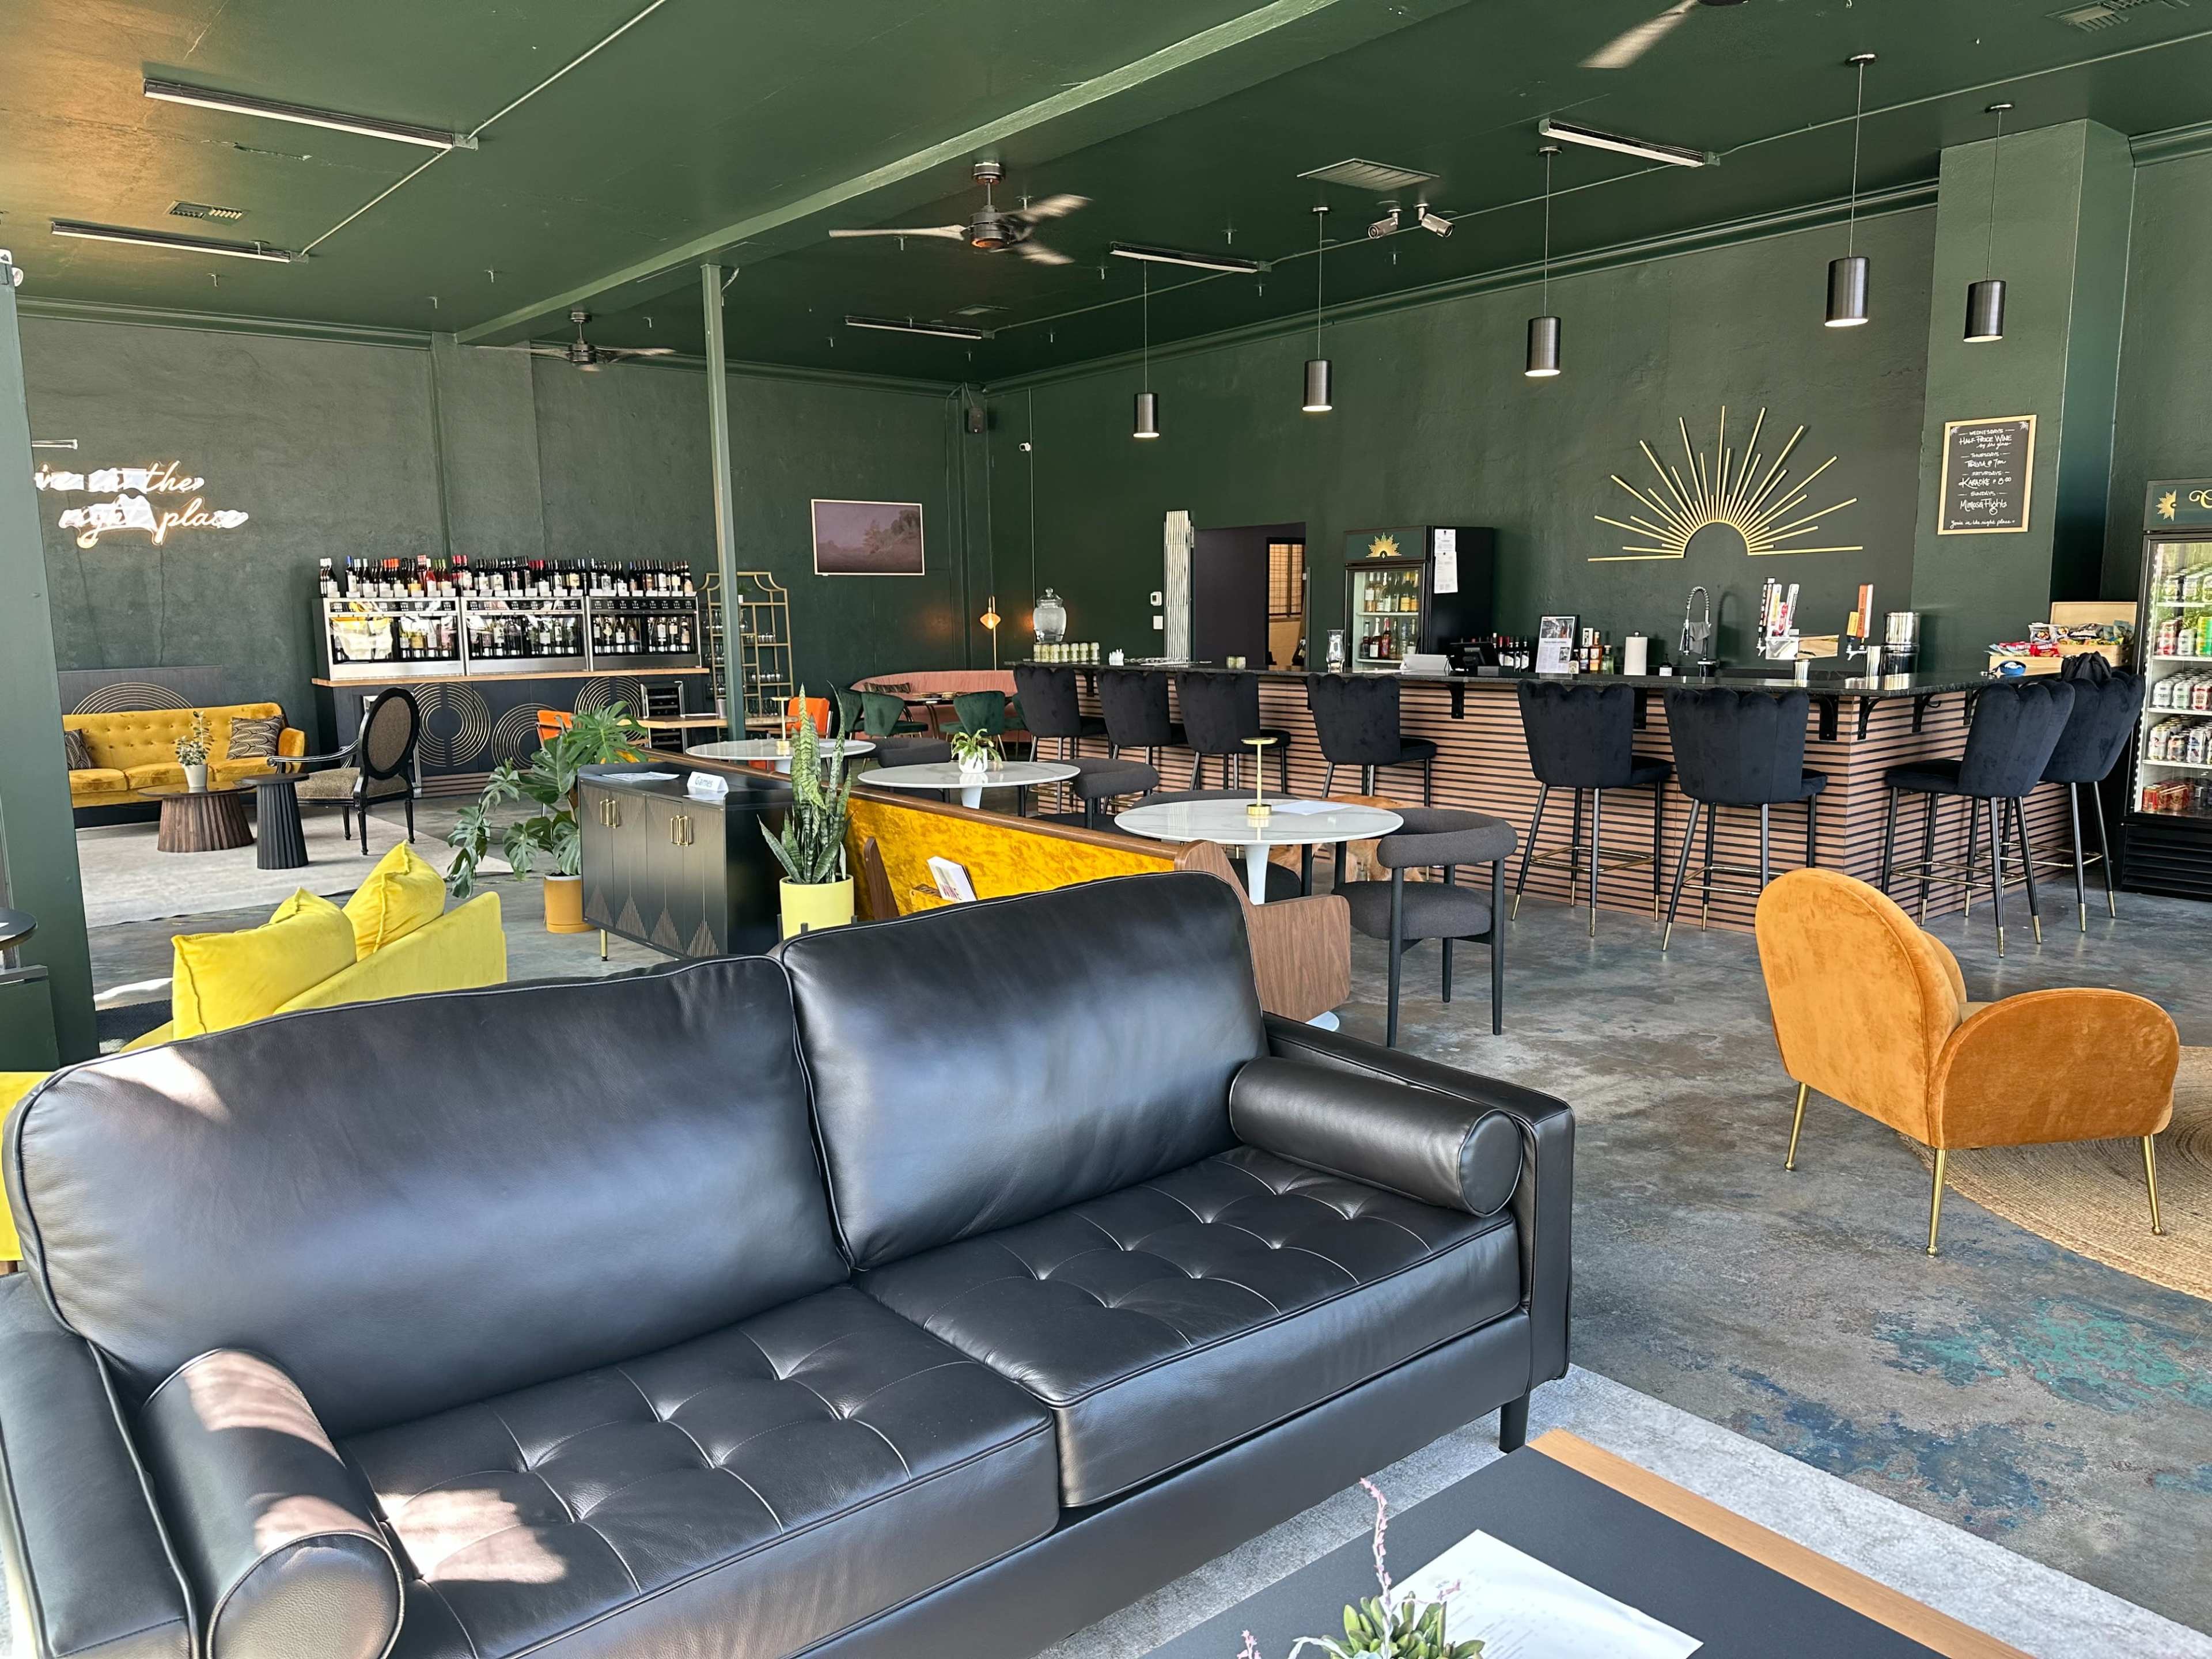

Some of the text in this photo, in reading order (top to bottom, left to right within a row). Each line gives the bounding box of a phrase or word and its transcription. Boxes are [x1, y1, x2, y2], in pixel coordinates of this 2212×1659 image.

[1959, 437, 1976, 445] HALF
[1994, 434, 2012, 444] WINE
[1959, 477, 1991, 489] KARAOKE
[1959, 498, 2008, 516] Mimosa Flights
[695, 775, 713, 787] Games
